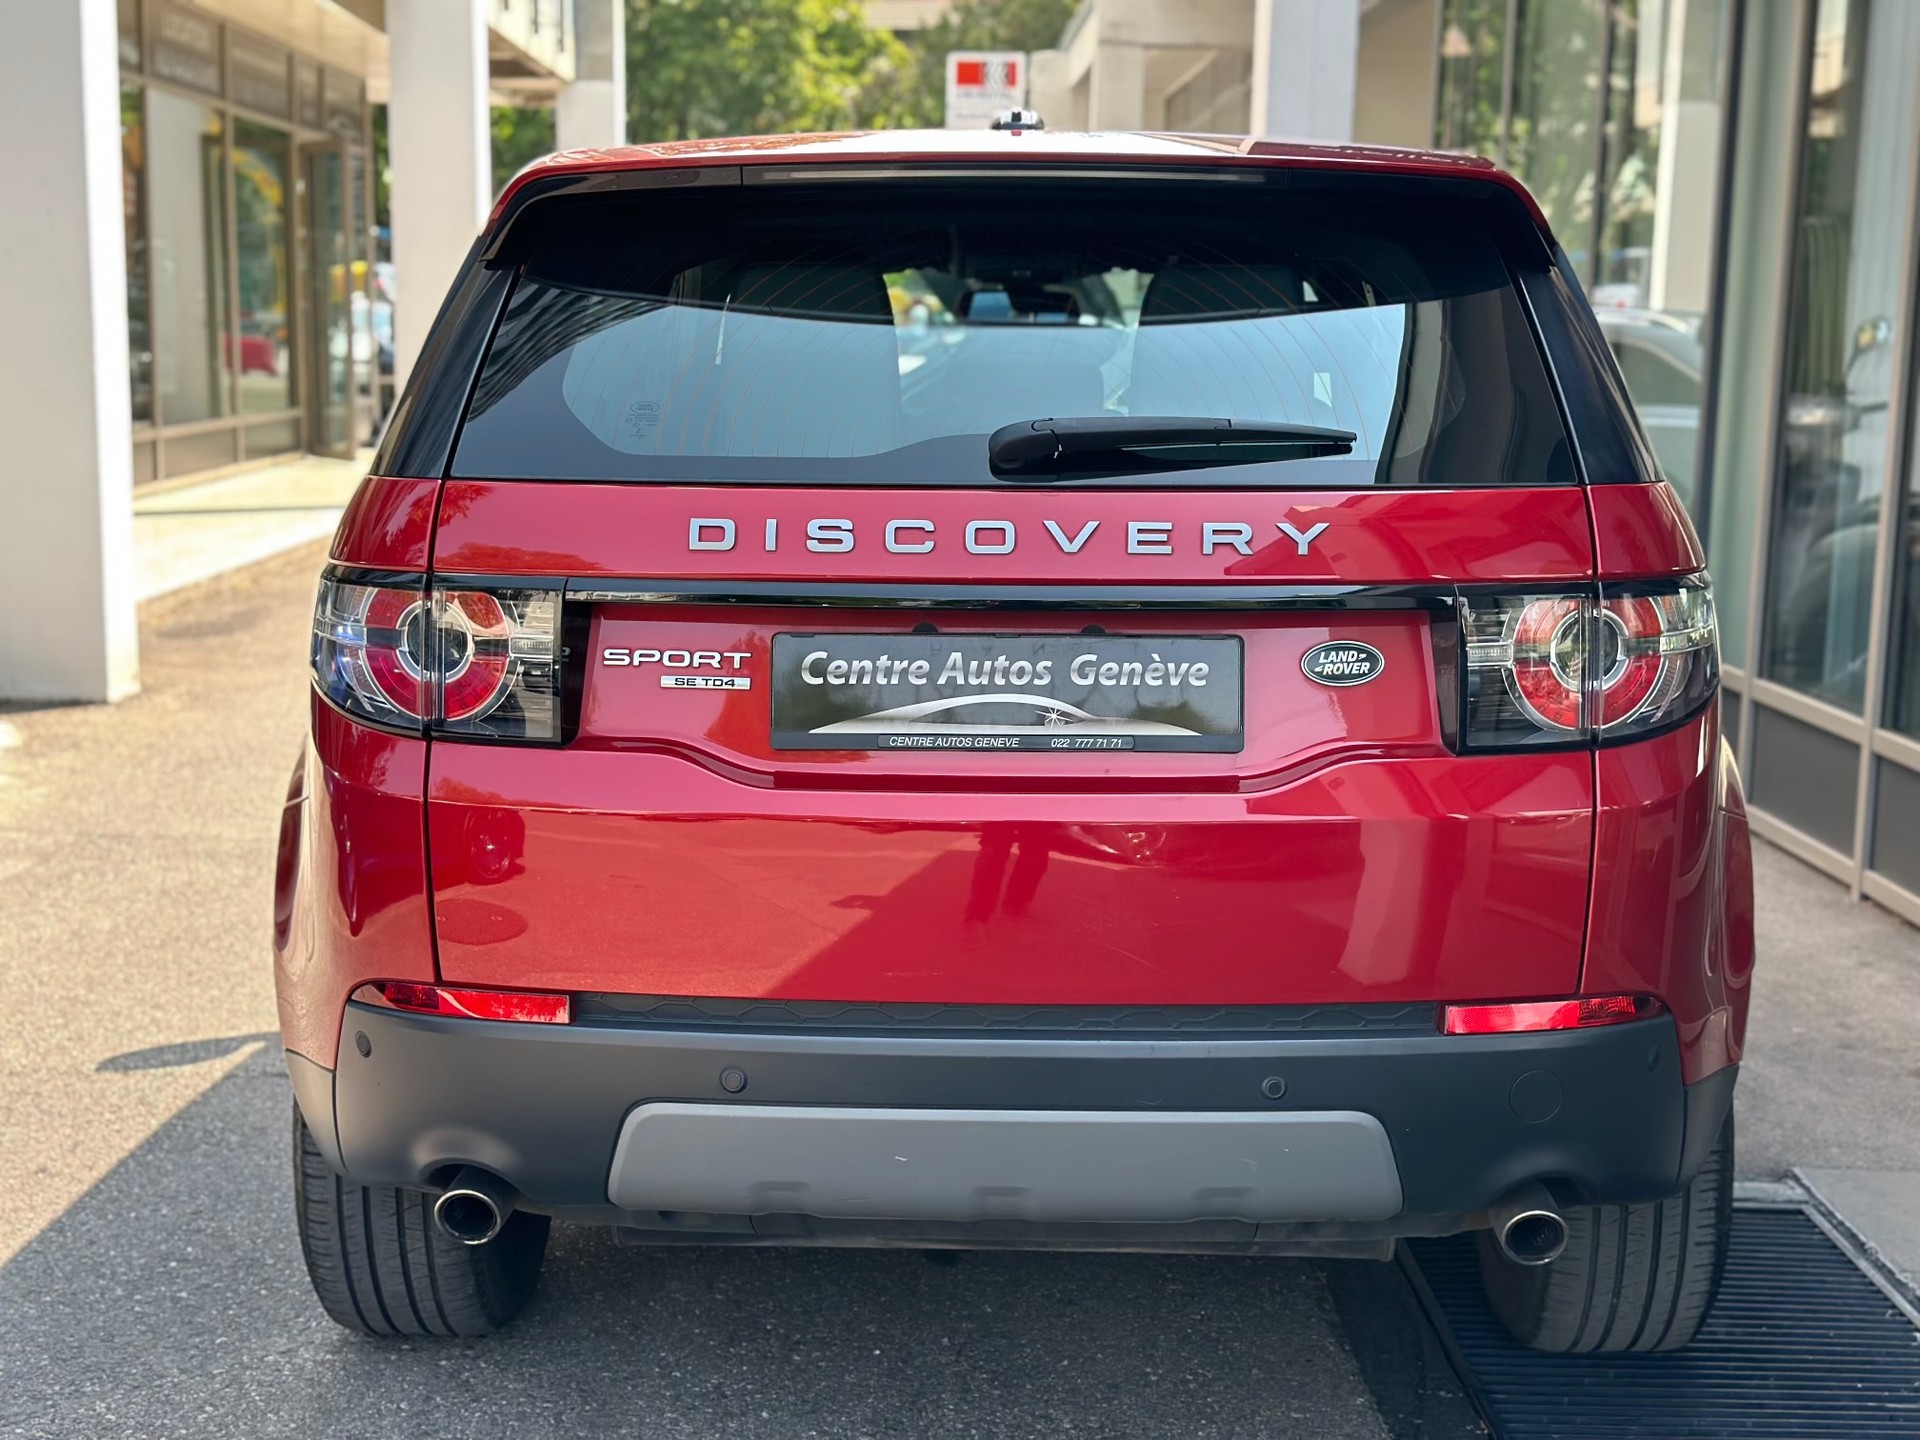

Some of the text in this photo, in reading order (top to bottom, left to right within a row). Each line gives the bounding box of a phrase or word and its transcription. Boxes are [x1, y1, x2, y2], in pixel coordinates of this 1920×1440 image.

[687, 517, 1331, 557] DISCOVERY
[602, 647, 752, 670] SPORT
[1318, 650, 1358, 664] LAND
[800, 651, 1211, 688] Centre Autos Genève
[1322, 662, 1371, 676] ROVER
[674, 676, 736, 688] SE TD4
[889, 736, 1020, 748] CENTRE AUTOS GENEVE
[1051, 738, 1123, 748] 022 777 71 71
